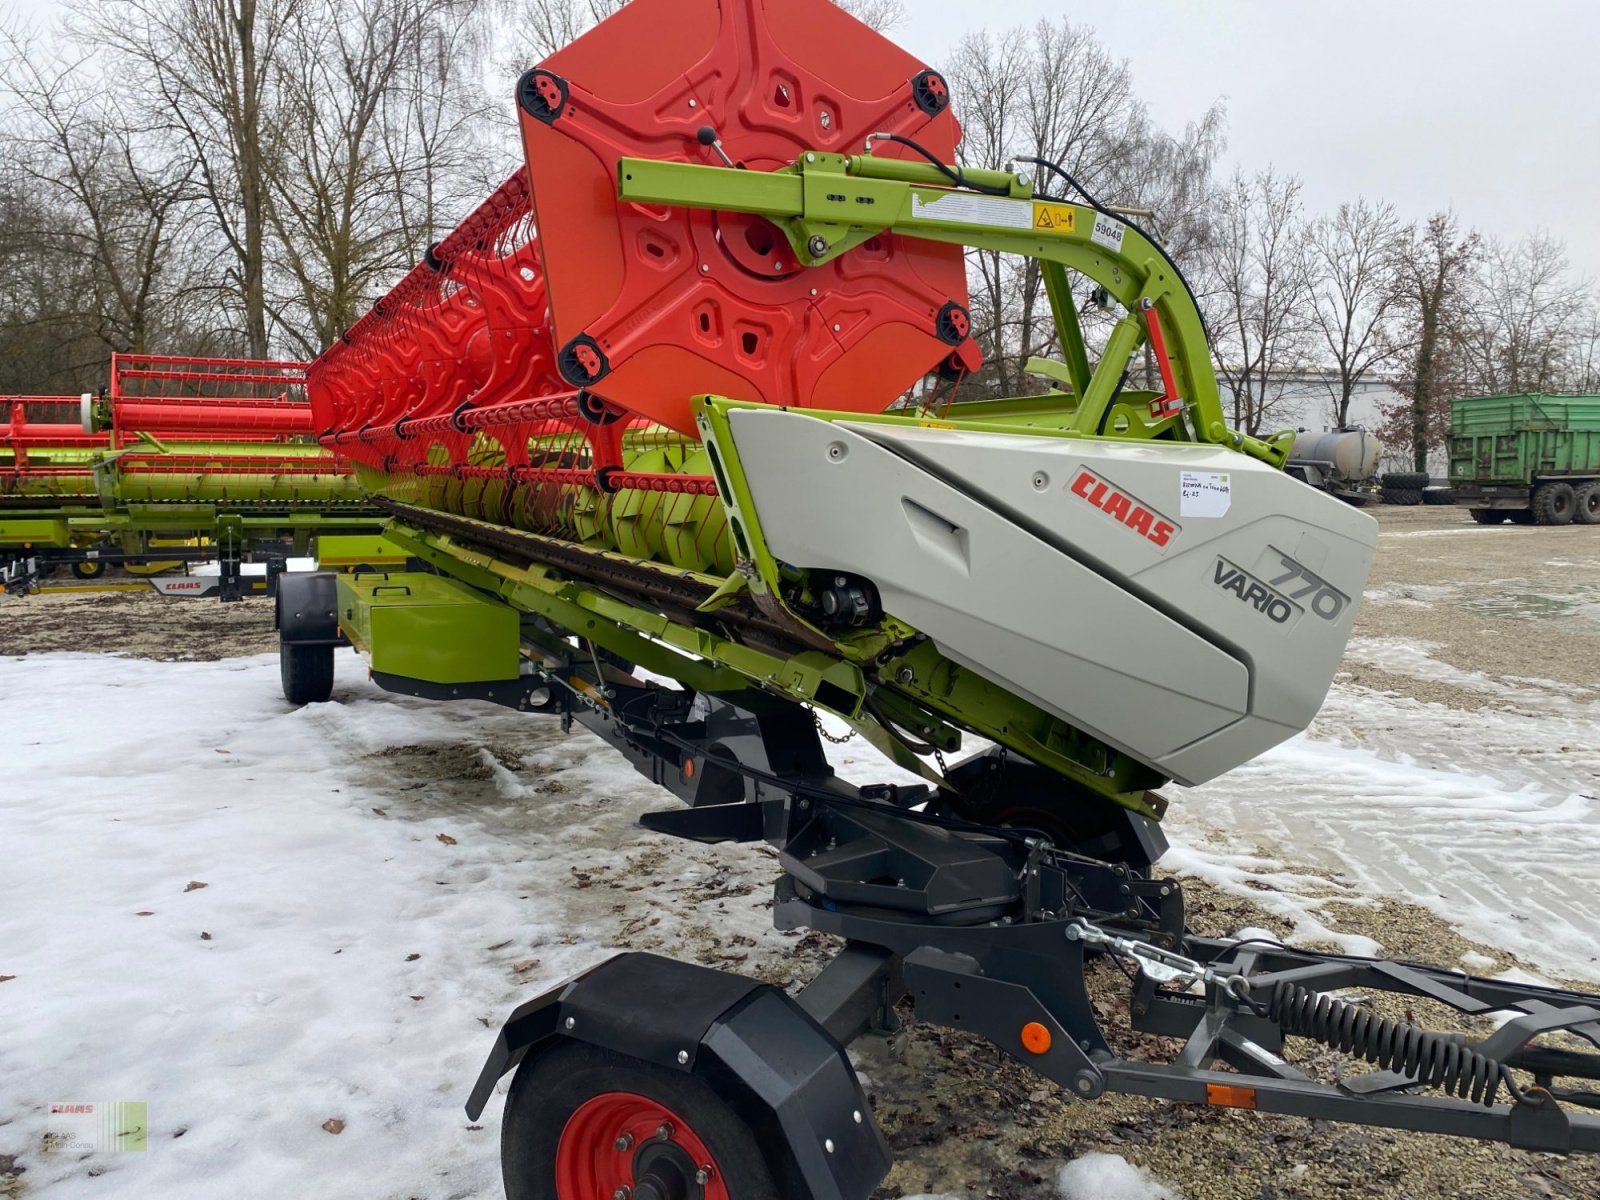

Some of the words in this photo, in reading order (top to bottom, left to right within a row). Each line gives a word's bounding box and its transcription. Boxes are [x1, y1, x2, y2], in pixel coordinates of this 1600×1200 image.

[1096, 222, 1122, 241] 59048
[1071, 472, 1174, 547] CLAAS
[166, 582, 201, 590] CLAAS
[1213, 560, 1292, 624] VARIO
[1269, 558, 1342, 621] 770
